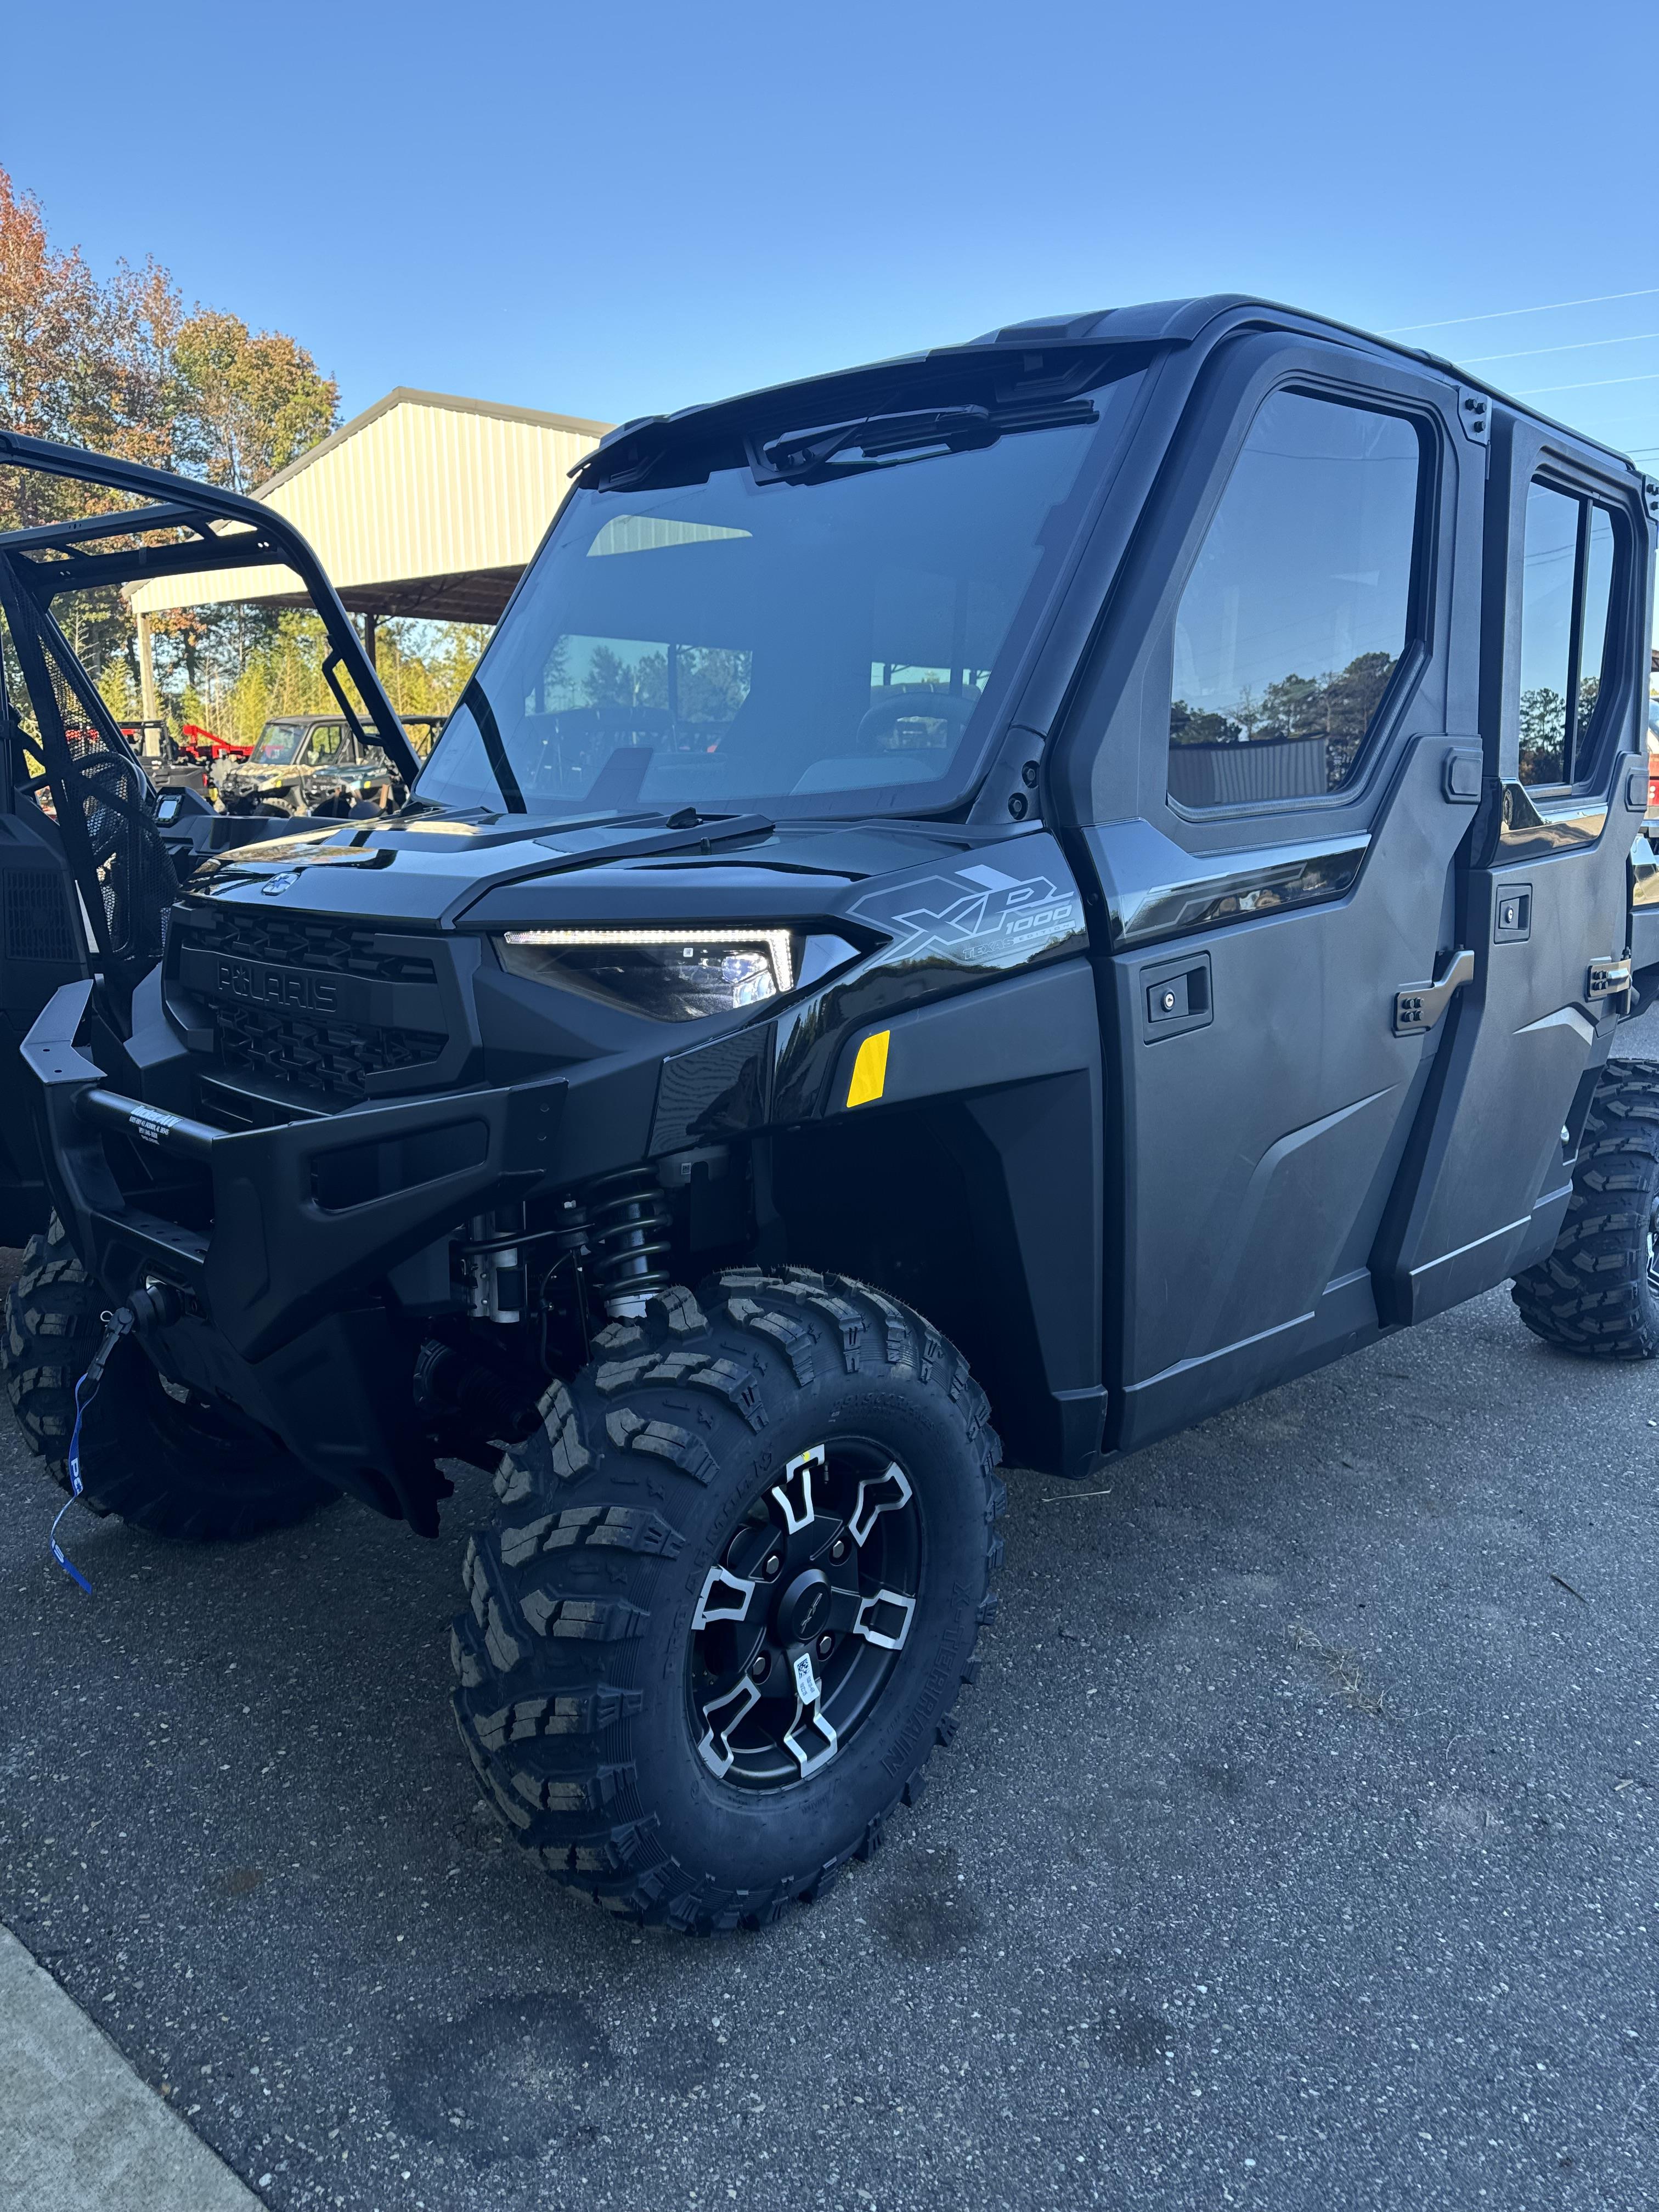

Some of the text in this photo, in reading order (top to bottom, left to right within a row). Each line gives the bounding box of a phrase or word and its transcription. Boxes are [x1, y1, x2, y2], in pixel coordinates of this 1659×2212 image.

[865, 876, 1074, 971] XP
[962, 923, 1071, 961] TEXAS EDITION
[1005, 905, 1073, 935] 1000
[217, 960, 337, 1013] POLARIS
[881, 1581, 974, 1777] X-TERRAIN
